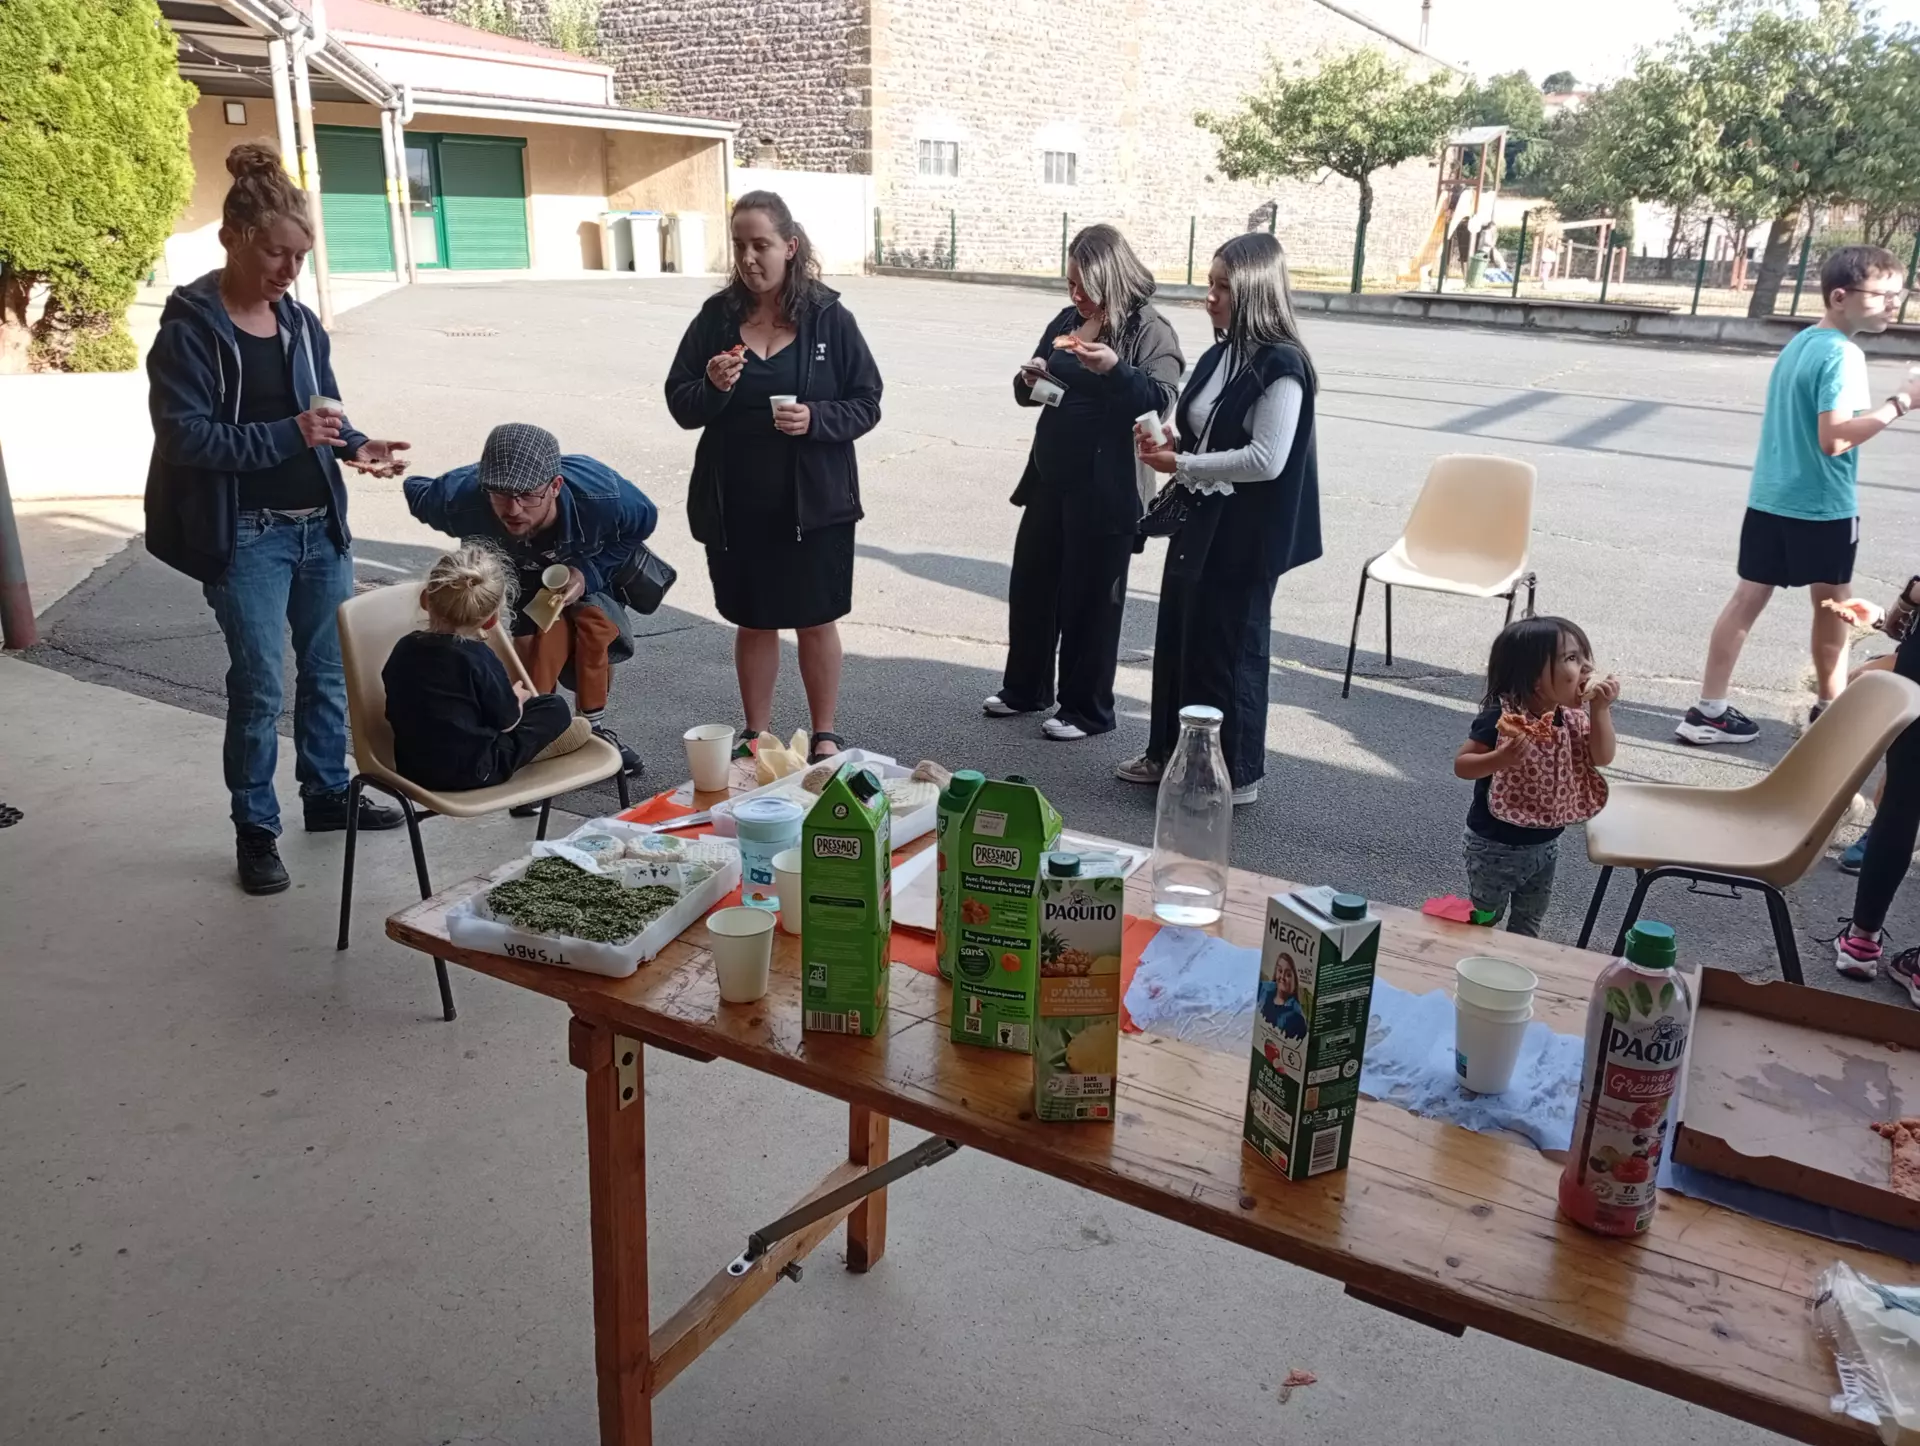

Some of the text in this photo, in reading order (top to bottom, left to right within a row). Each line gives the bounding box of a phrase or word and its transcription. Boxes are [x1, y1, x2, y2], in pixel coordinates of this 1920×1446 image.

[816, 837, 858, 855] PRESSADE
[976, 846, 1018, 866] PRESSADE
[1045, 903, 1117, 922] PAQUITO
[504, 943, 571, 965] T'SABA
[960, 947, 985, 956] sans
[1068, 978, 1091, 988] JUS
[1051, 988, 1107, 998] D'ANANAS
